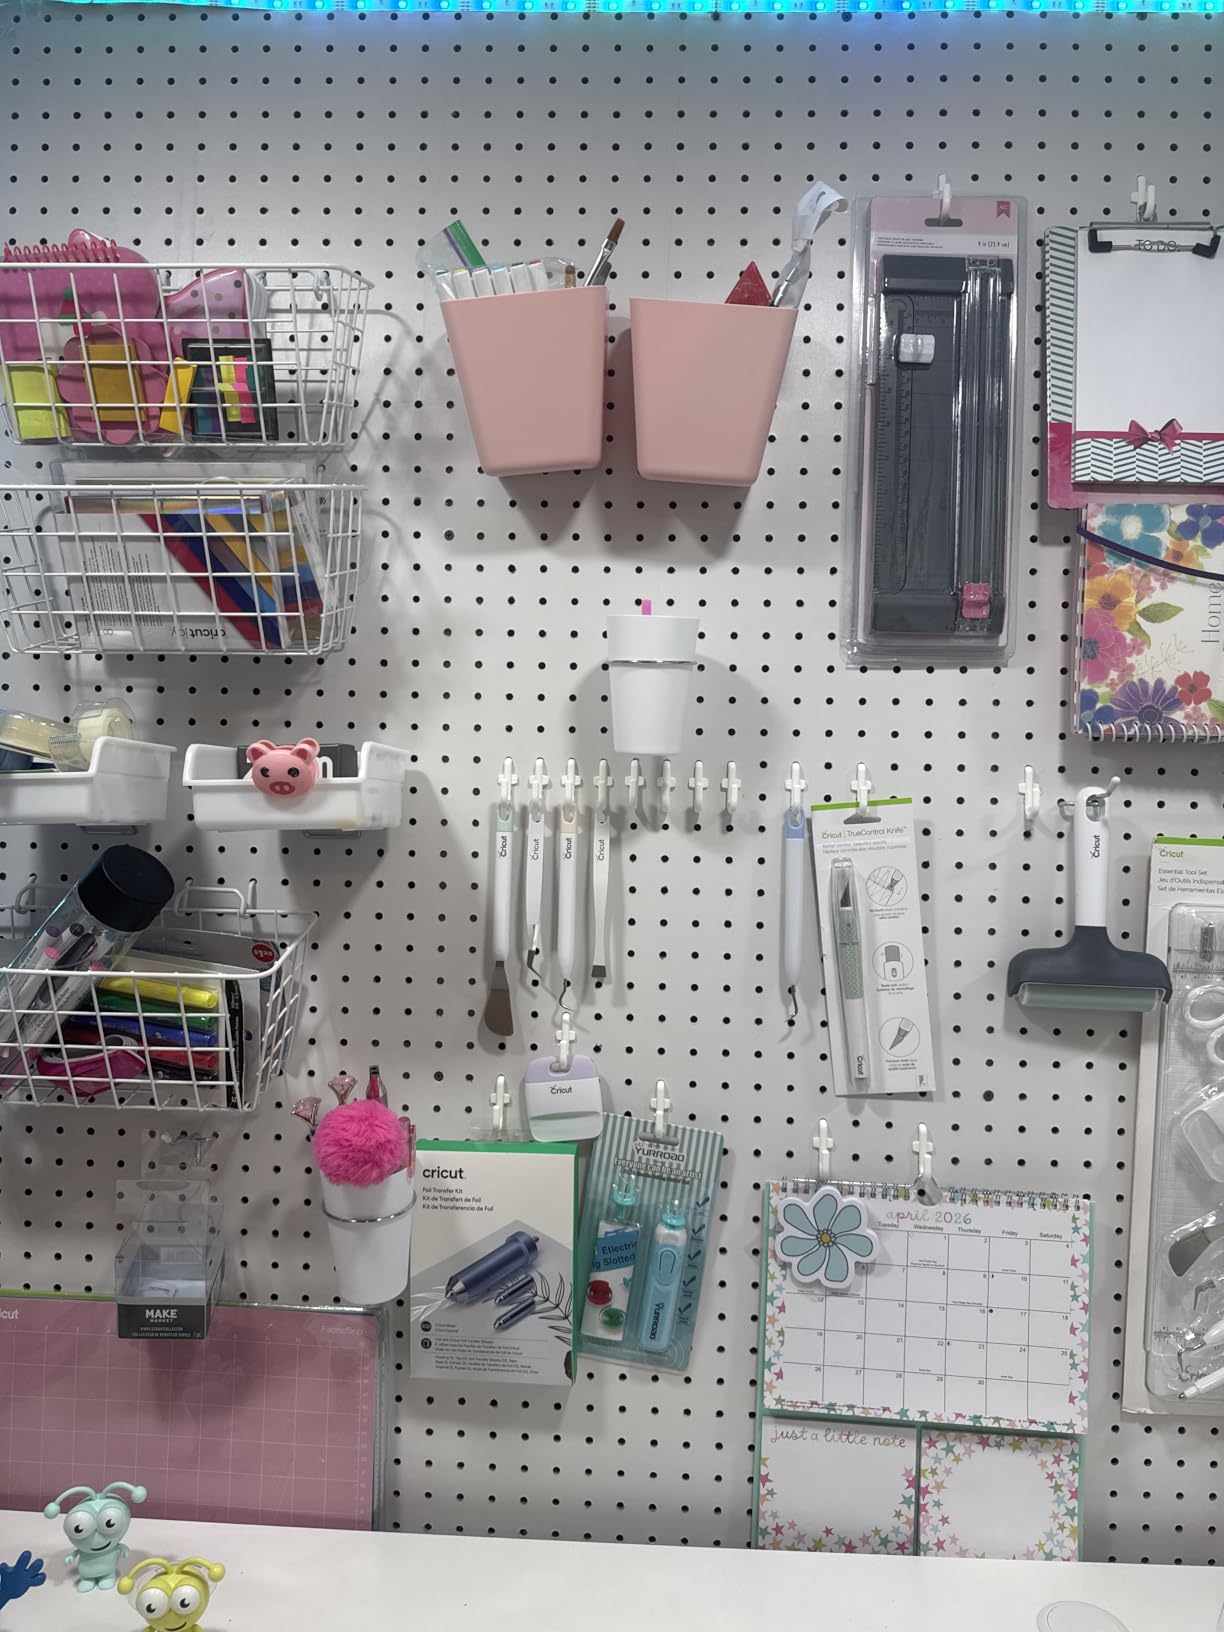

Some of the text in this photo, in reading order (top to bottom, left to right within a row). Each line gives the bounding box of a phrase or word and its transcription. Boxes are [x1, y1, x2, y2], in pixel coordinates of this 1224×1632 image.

[1200, 583, 1222, 643] Home
[821, 831, 842, 840] Cricut
[847, 828, 885, 838] TrueControl
[499, 835, 507, 858] Cricut
[531, 838, 540, 861] Cricut
[564, 837, 572, 860] Cricut
[597, 839, 605, 861] Cricut
[1090, 834, 1101, 859] Cricut
[1159, 848, 1184, 859] Cricut
[1158, 867, 1184, 875] Essential
[1177, 886, 1215, 894] Herramientas
[550, 1085, 573, 1095] Cricut
[614, 1156, 647, 1170] Everyone
[647, 1164, 661, 1172] can
[661, 1165, 671, 1175] be
[671, 1168, 681, 1176] an
[681, 1168, 702, 1180] artist
[439, 1204, 475, 1212] Transferencia
[877, 1221, 900, 1229] Tuesday
[886, 1210, 972, 1225] april 2026
[145, 1308, 178, 1319] MAKE
[770, 1425, 906, 1448] just a little note
